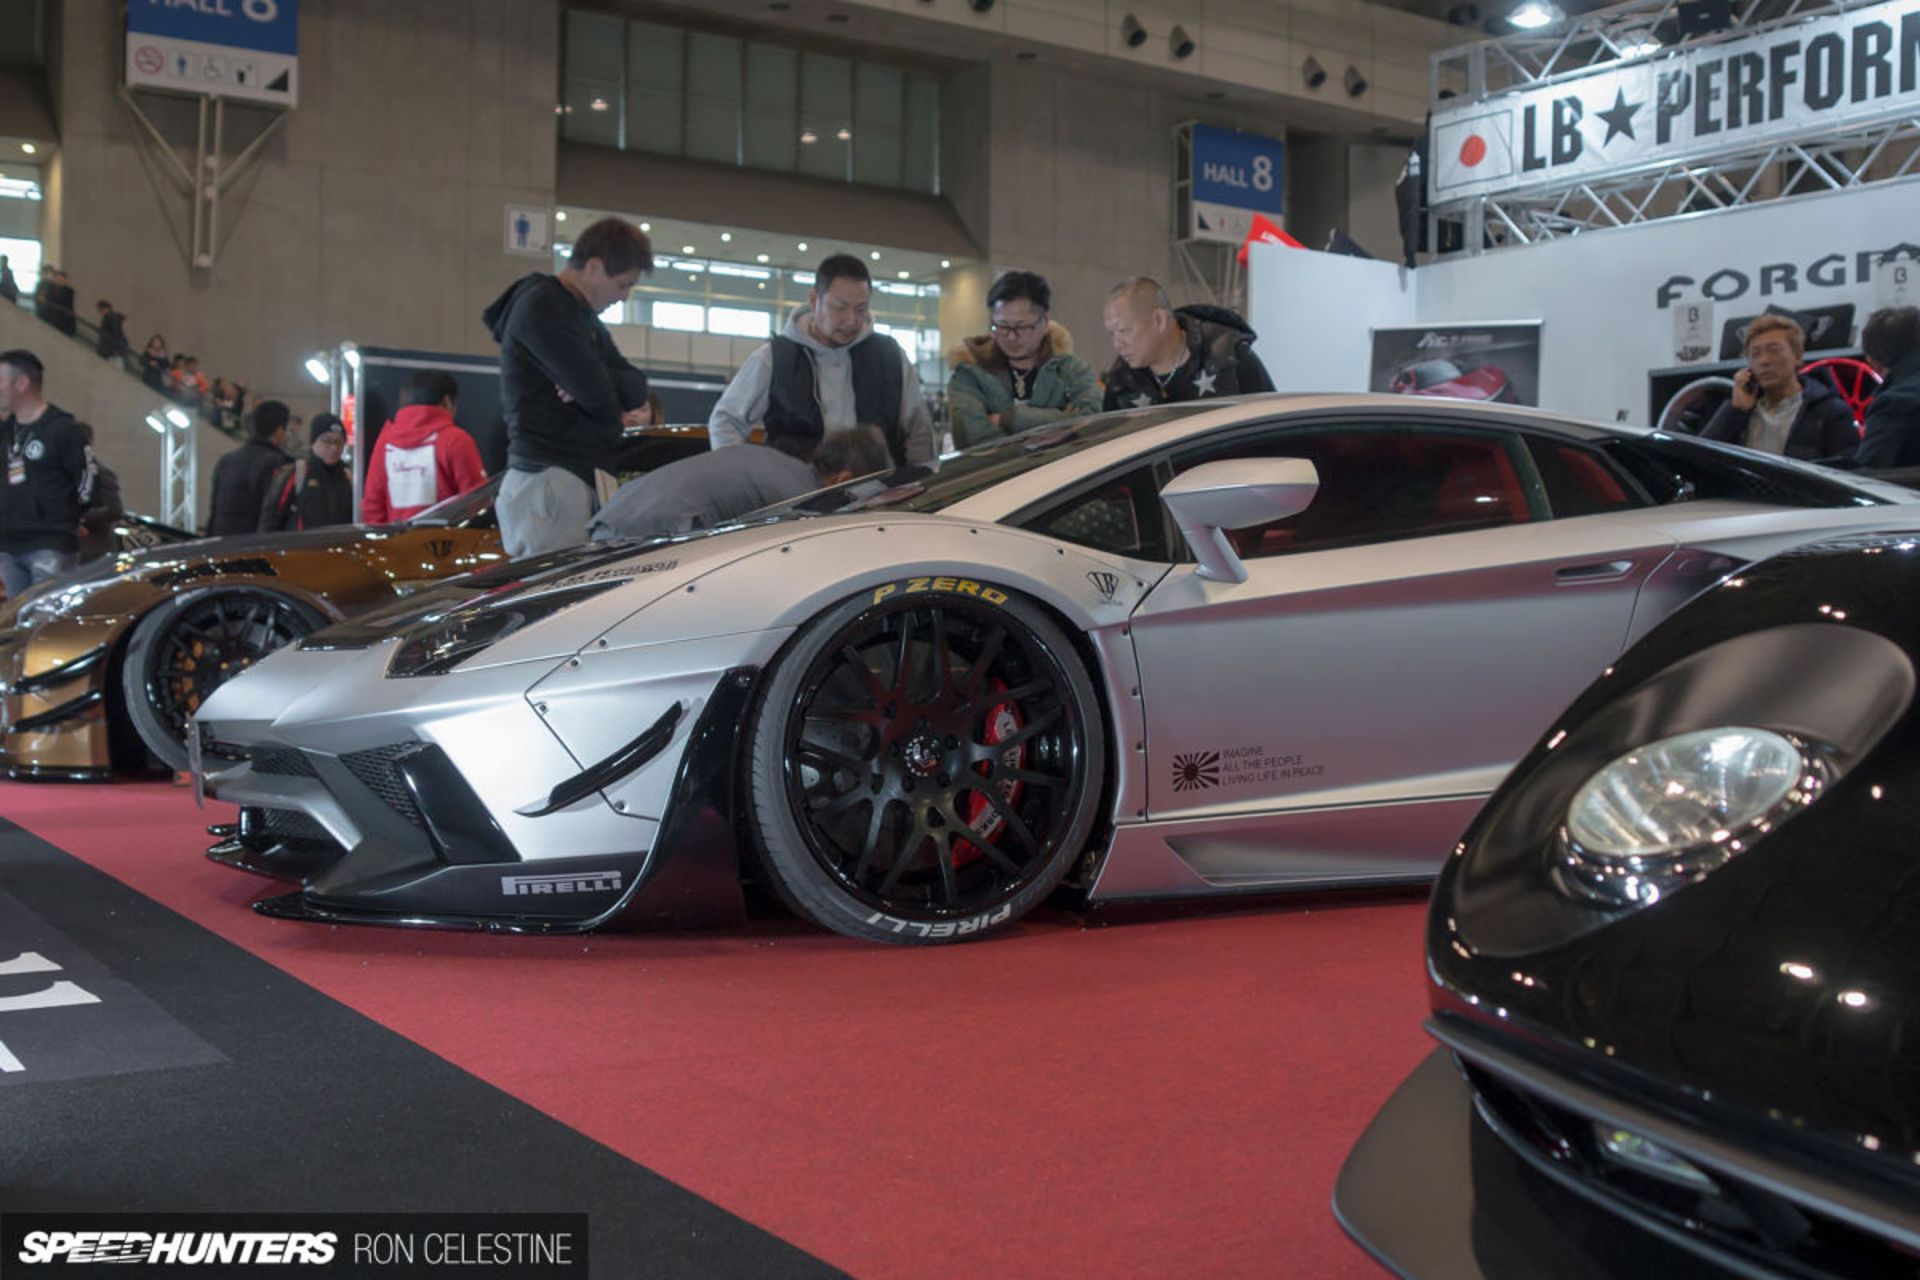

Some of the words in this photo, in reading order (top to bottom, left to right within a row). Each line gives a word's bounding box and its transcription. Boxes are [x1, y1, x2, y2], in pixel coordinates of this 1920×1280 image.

[1523, 96, 1583, 172] LB
[1203, 161, 1249, 189] HALL
[1252, 154, 1274, 192] 8
[872, 583, 897, 606] P
[905, 576, 1009, 606] ZERO
[1222, 760, 1241, 773] ALL
[1243, 758, 1262, 770] THE
[1264, 755, 1303, 768] PEOPLE
[1223, 745, 1264, 759] IMAGINE
[1222, 773, 1255, 786] LIVING
[1257, 769, 1279, 782] LIFE
[1280, 768, 1291, 779] IN
[1292, 765, 1325, 778] PEACE
[501, 870, 622, 895] PIRELLI
[866, 903, 1012, 937] PIRELLI
